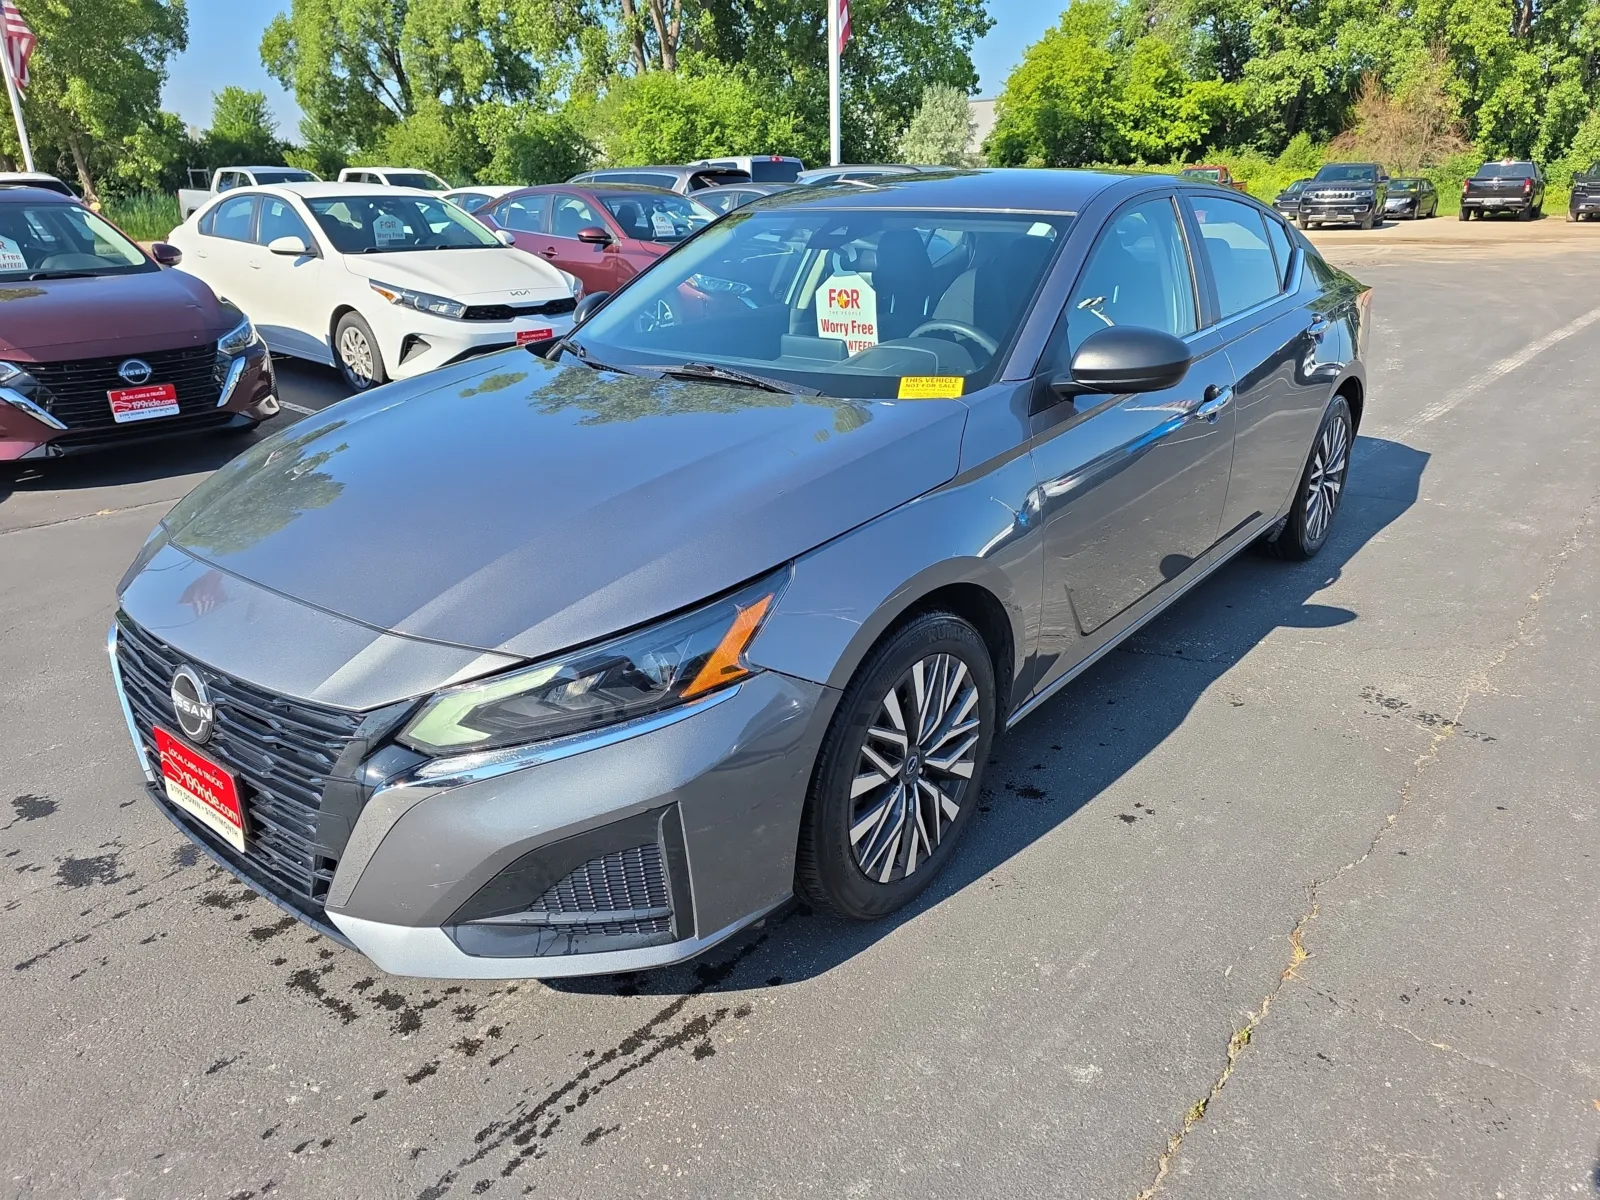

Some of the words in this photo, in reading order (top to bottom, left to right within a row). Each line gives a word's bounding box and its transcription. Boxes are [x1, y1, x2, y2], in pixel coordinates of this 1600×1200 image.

[380, 221, 397, 230] FOR
[2, 253, 21, 262] Free
[828, 288, 861, 310] FOR
[820, 318, 849, 337] Worry
[851, 319, 874, 335] Free
[119, 367, 153, 377] NISSAN
[131, 398, 177, 410] 199ride.com
[168, 747, 185, 764] LOCAL
[184, 758, 199, 773] CARS
[202, 769, 224, 790] TRUCKS
[170, 783, 183, 797] $199
[183, 791, 201, 810] DOWN
[183, 771, 240, 825] 199ride.com
